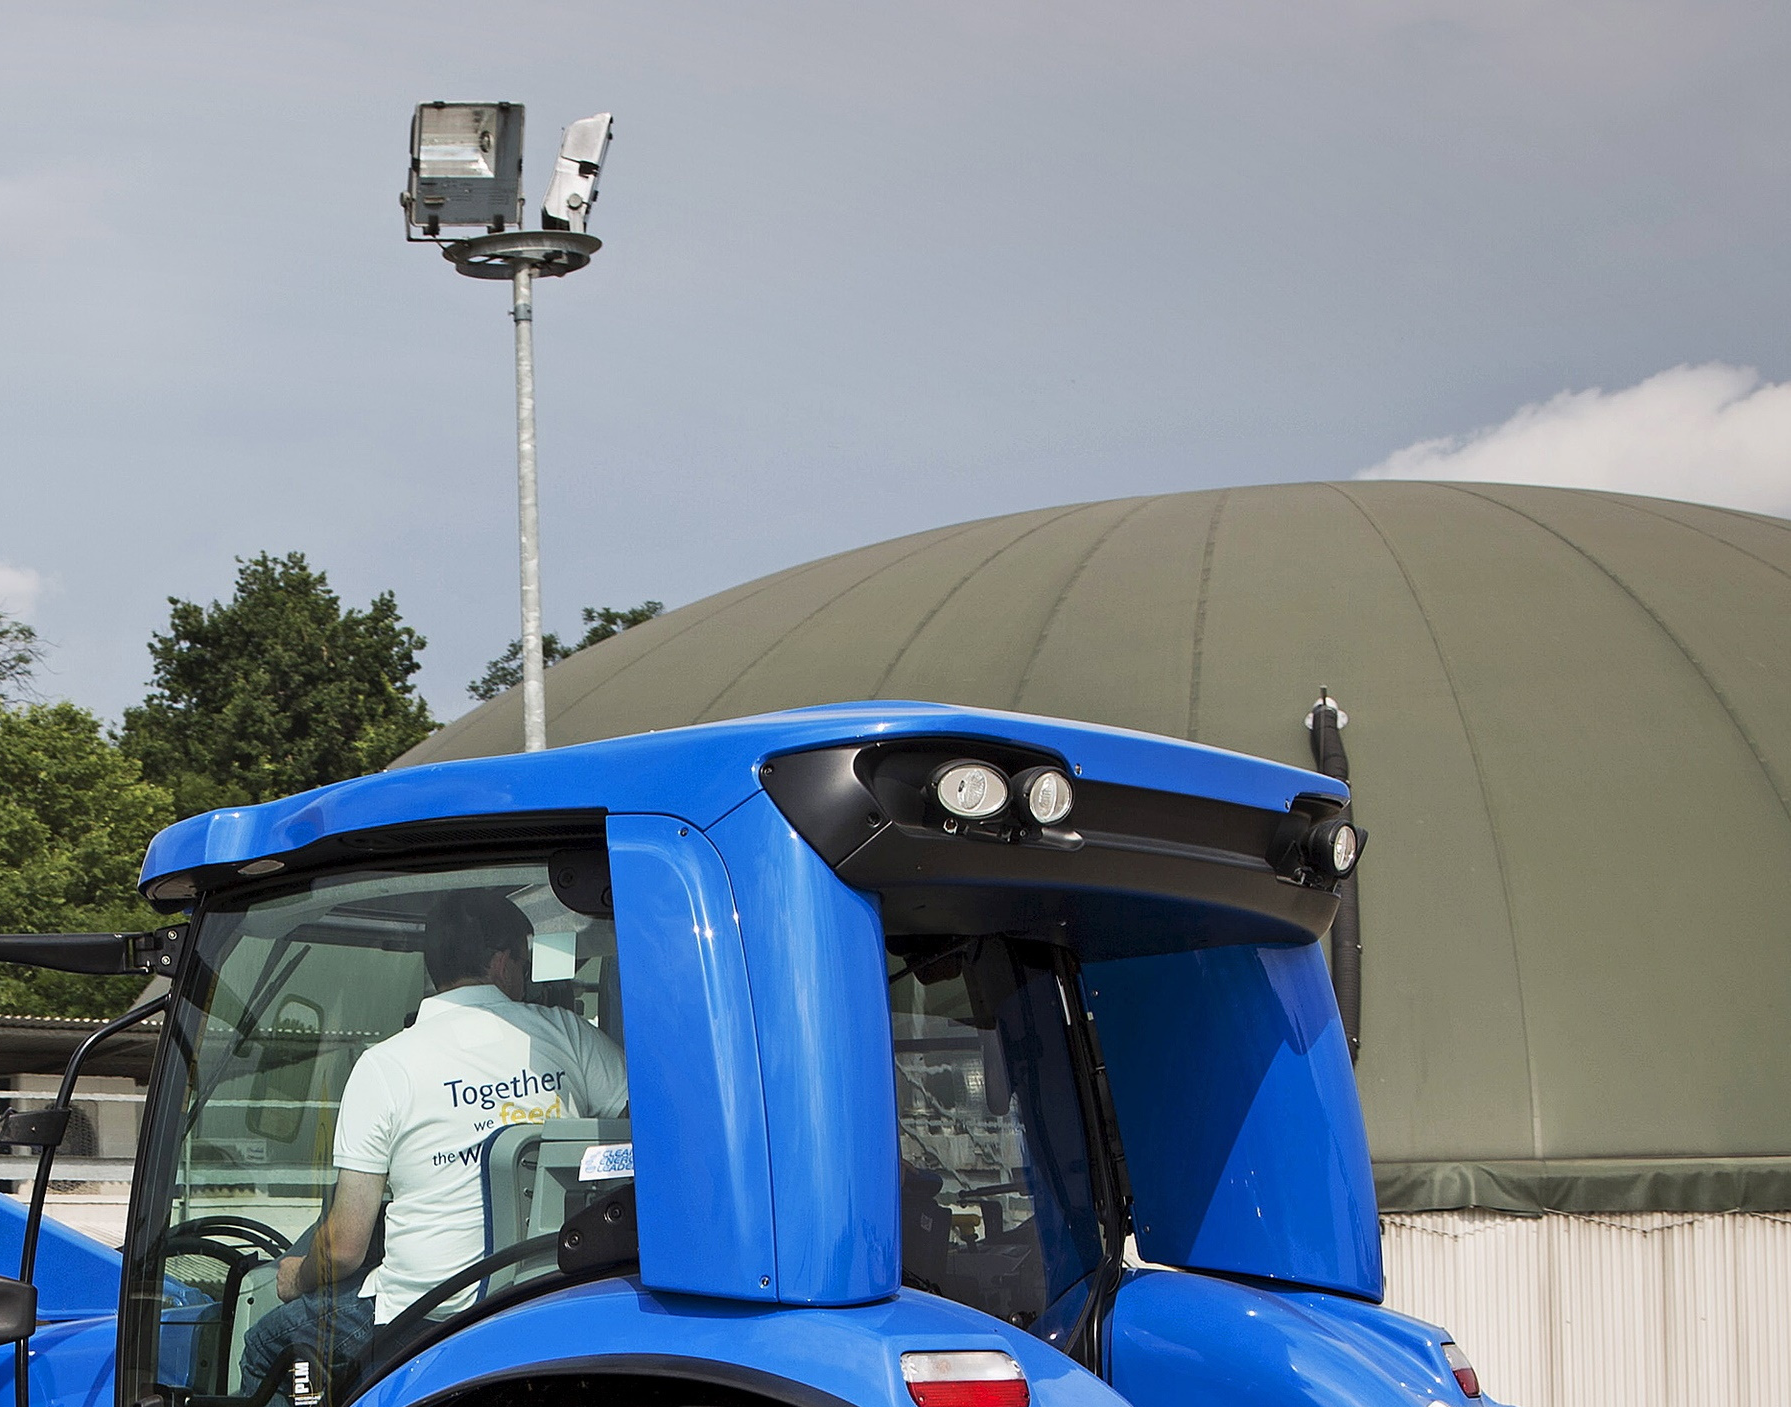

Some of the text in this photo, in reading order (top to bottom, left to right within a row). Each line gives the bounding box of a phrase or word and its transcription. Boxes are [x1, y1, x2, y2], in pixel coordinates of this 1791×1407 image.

[444, 1069, 566, 1110] Together
[474, 1095, 561, 1133] we feed
[432, 1151, 456, 1167] the
[603, 1148, 633, 1158] CLEA
[597, 1162, 634, 1172] LEADE
[294, 1362, 310, 1394] PLM
